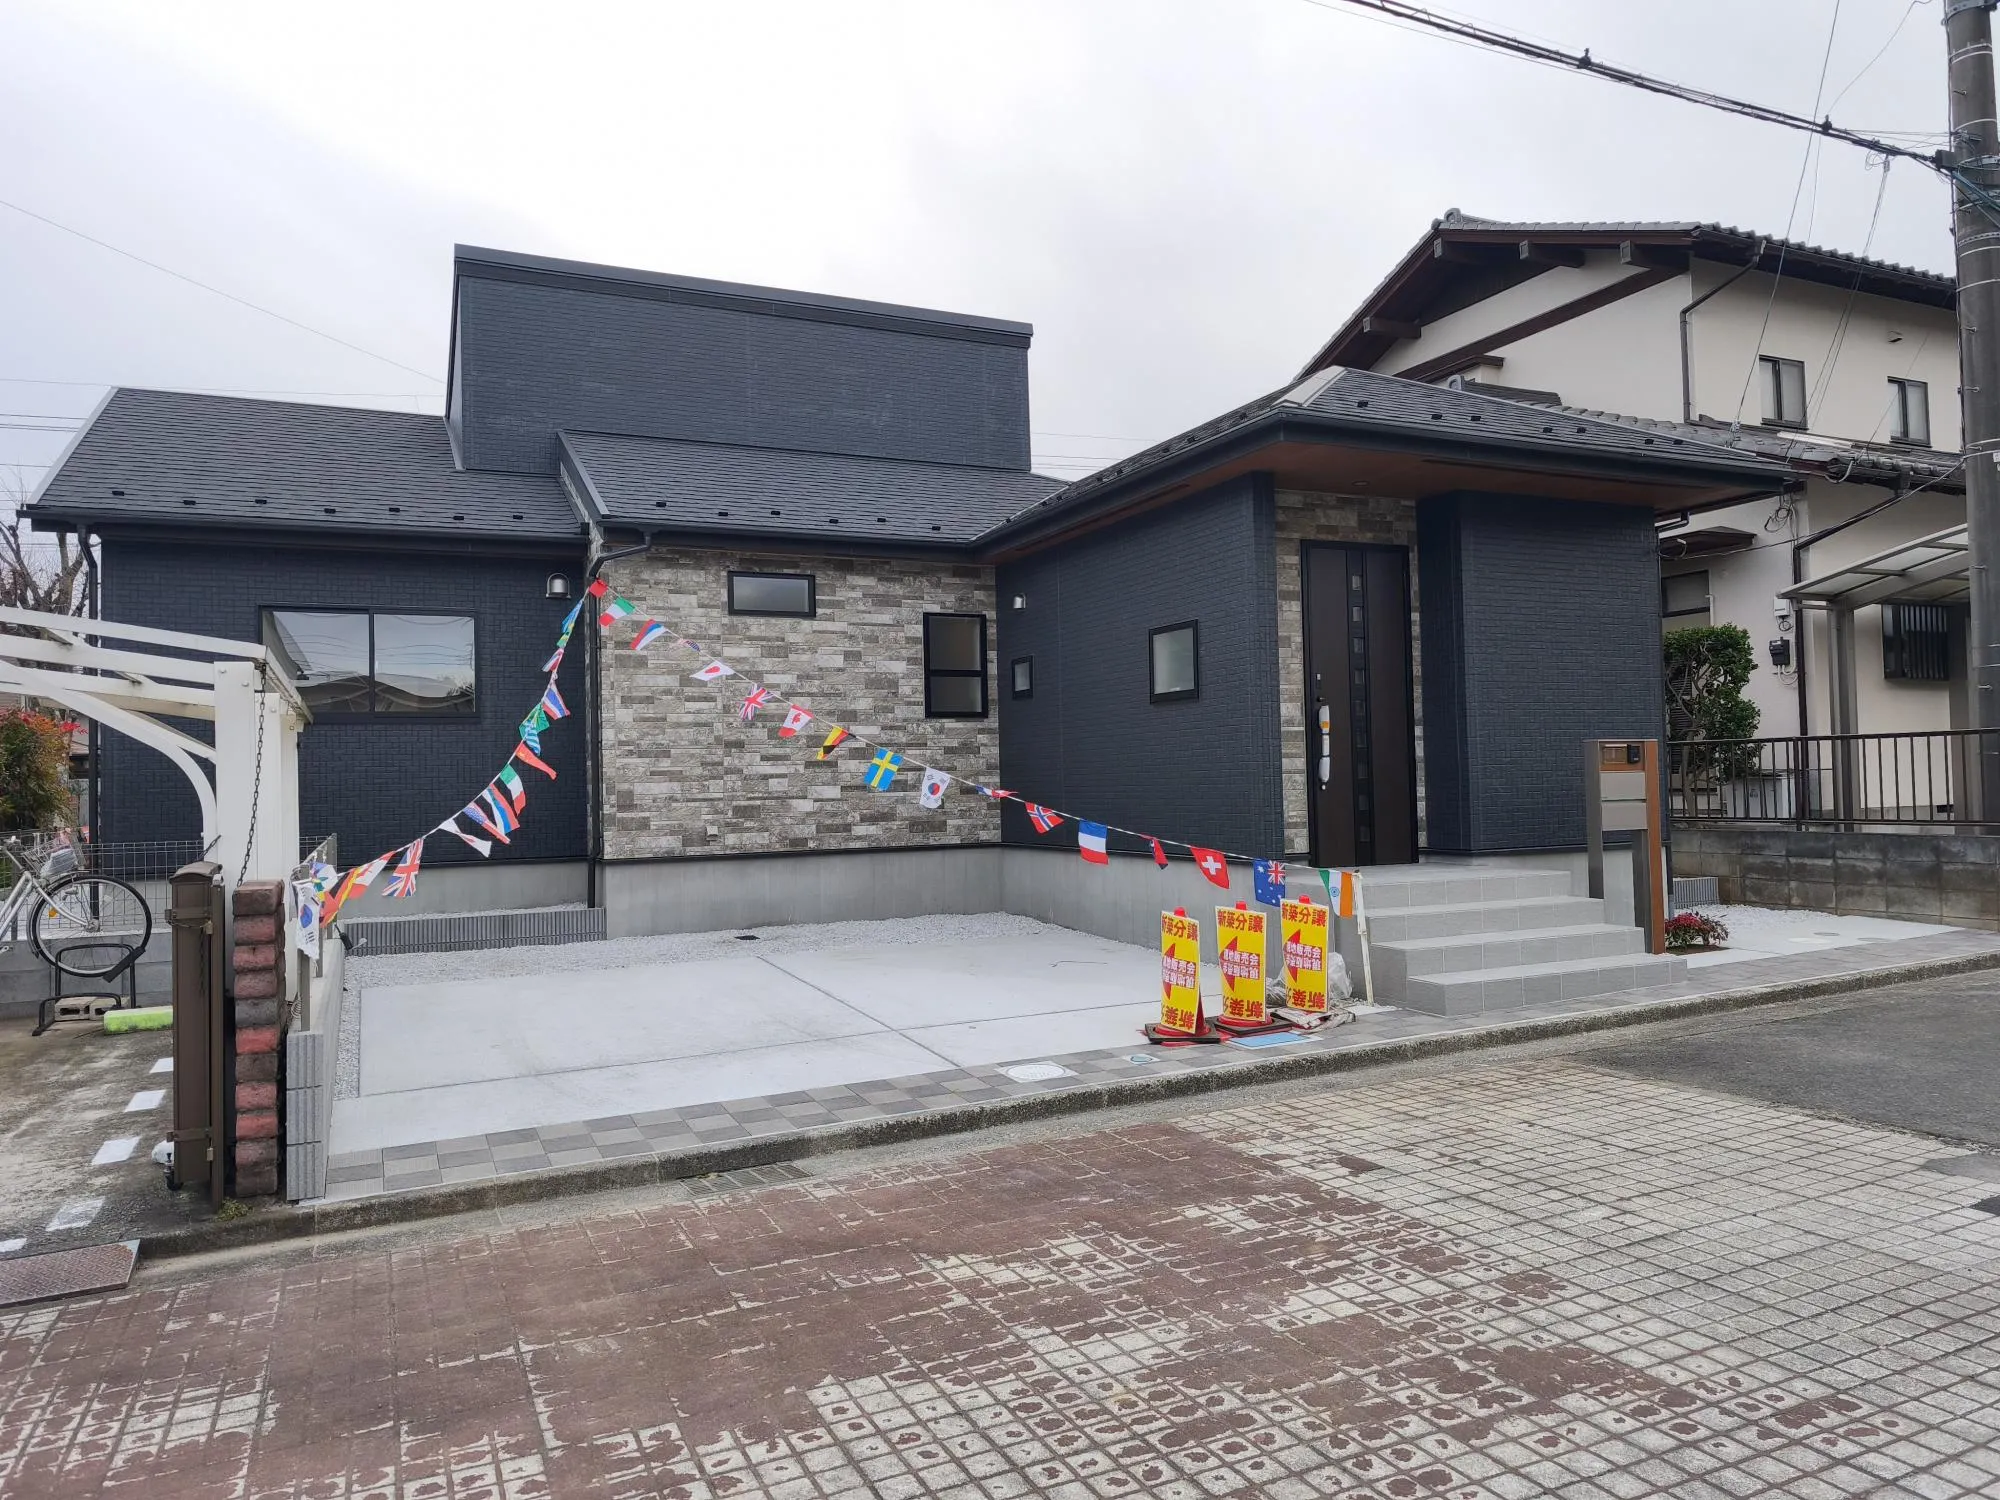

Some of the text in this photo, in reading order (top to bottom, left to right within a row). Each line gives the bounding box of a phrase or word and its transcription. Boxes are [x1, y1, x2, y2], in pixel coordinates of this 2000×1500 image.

[1218, 910, 1264, 934] 新築分譲
[1281, 903, 1327, 927] 新築分譲
